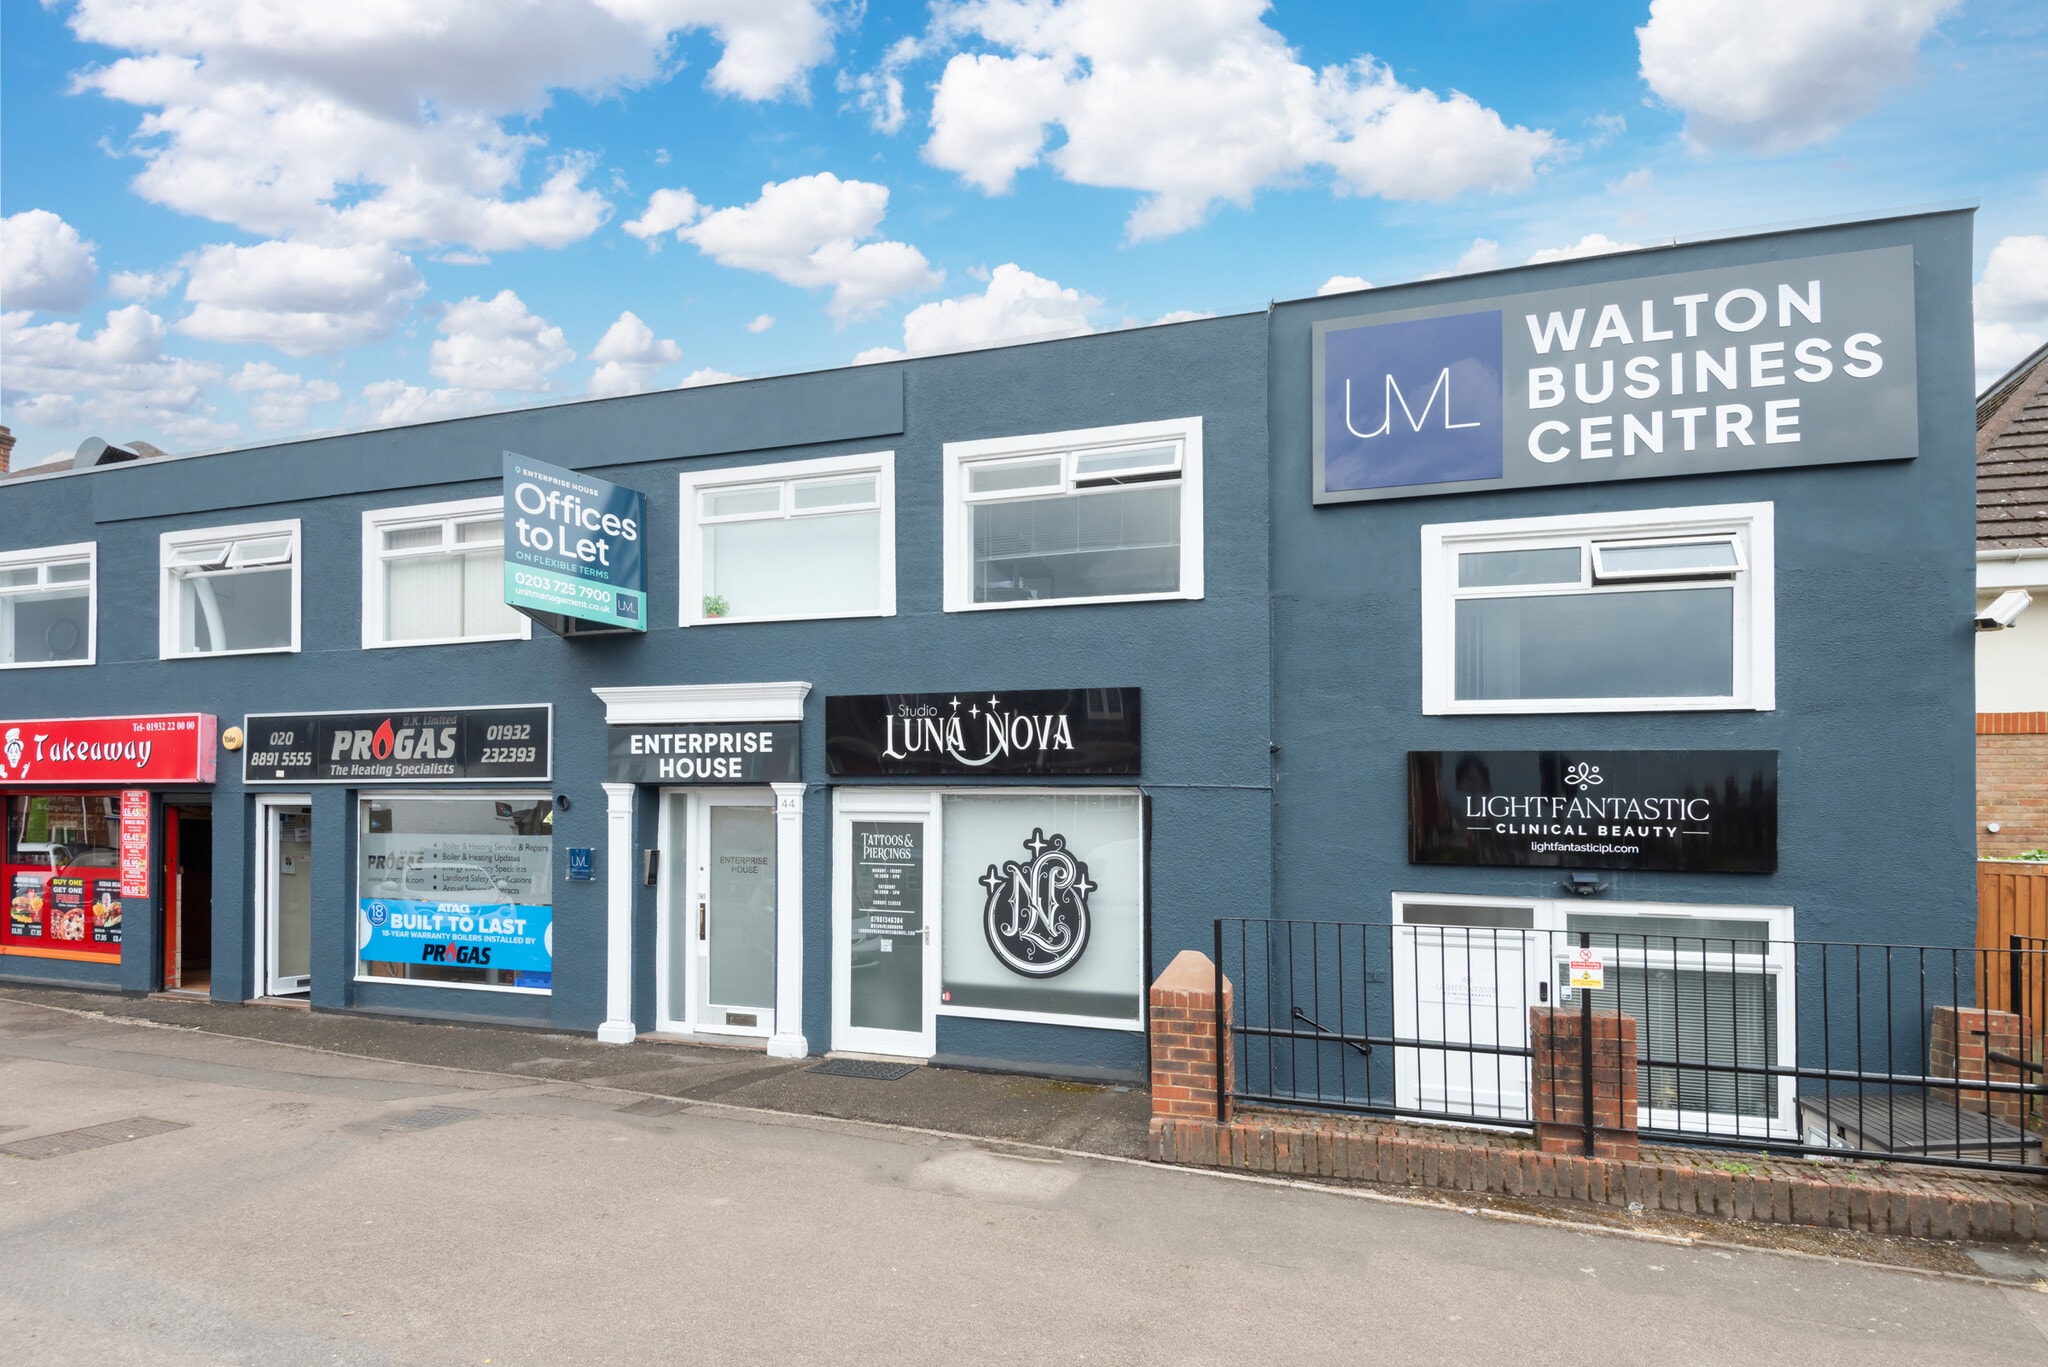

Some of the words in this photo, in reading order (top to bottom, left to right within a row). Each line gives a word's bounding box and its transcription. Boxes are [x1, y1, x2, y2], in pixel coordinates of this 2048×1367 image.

[1525, 280, 1821, 354] WALTON
[1528, 333, 1884, 409] BUSINESS
[1528, 398, 1801, 463] CENTRE
[523, 469, 570, 489] ENTERPRISE
[572, 483, 599, 496] HOUSE
[515, 482, 637, 541] Offices
[515, 518, 553, 551] to
[559, 525, 609, 567] Let
[515, 551, 532, 562] ON
[533, 555, 577, 573] FLEXIBLE
[579, 566, 609, 580] TERMS
[515, 572, 551, 591] 0203
[553, 579, 576, 596] 725
[578, 585, 611, 603] 7900
[515, 587, 611, 613] unitmanagement.co.uk
[898, 704, 938, 718] Studio
[132, 723, 145, 732] Tel-
[146, 722, 165, 732] 01932
[167, 721, 175, 731] 22
[176, 721, 185, 731] 00
[186, 721, 195, 730] 00
[402, 716, 420, 727] U.K.
[423, 715, 457, 726] Limited
[223, 735, 236, 744] Yale
[269, 731, 294, 746] 020
[486, 724, 531, 741] 01932
[882, 714, 967, 760] LUNA
[985, 712, 1075, 758] NOVA
[630, 732, 773, 755] ENTERPRISE
[33, 734, 152, 769] Takeaway
[251, 752, 279, 766] 8891
[281, 752, 312, 766] 5555
[480, 746, 536, 763] 232393
[330, 764, 348, 776] The
[351, 764, 392, 777] Heating
[395, 763, 455, 777] Specialists
[659, 757, 742, 778] HOUSE
[781, 799, 795, 809] 44
[1466, 796, 1548, 818] LIGHT
[1552, 797, 1710, 822] FANTASTIC
[1496, 823, 1588, 836] CLINICAL
[1598, 826, 1679, 838] BEAUTY
[861, 832, 903, 846] TATTOOS
[904, 833, 914, 848] &
[1531, 841, 1639, 854] lightfantasticipl.com
[518, 843, 523, 851] &
[525, 844, 549, 853] Repairs
[863, 846, 911, 861] PIERCINGS
[469, 854, 493, 863] Heating
[494, 854, 520, 863] Updates
[719, 856, 768, 866] ENTERPRISE
[731, 865, 758, 874] HOUSE
[53, 878, 67, 886] BUY
[442, 874, 469, 882] Landlord
[471, 875, 488, 884] Safety
[55, 894, 80, 904] FREE
[371, 904, 383, 917] 18
[437, 903, 470, 913] ATAG
[390, 913, 443, 931] BUILT
[448, 916, 474, 932] TO
[479, 918, 526, 935] LAST
[382, 929, 409, 938] 18-YEAR
[411, 931, 450, 940] WARRANTY
[452, 934, 482, 942] BOILERS
[484, 935, 523, 944] INSTALLED
